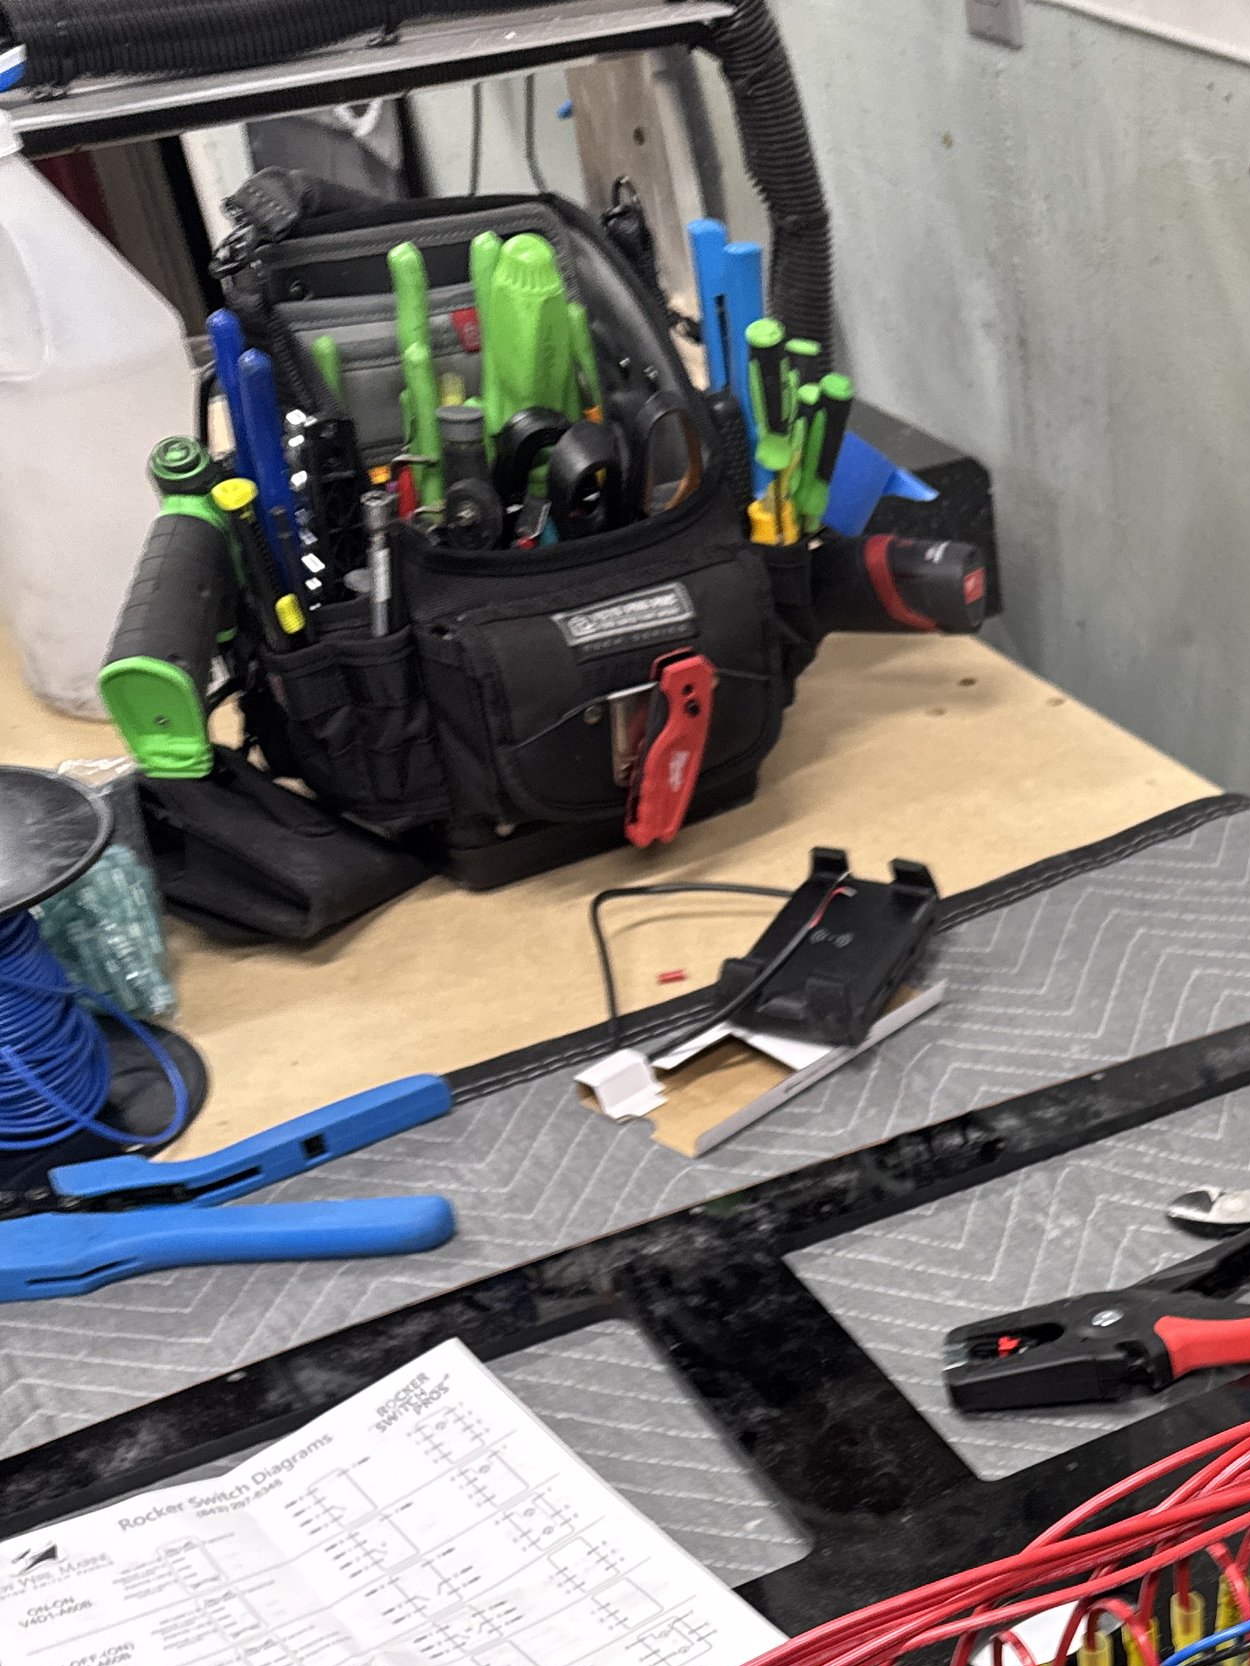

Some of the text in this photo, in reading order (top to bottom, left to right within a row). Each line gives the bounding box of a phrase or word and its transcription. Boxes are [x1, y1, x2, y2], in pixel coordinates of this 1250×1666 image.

[375, 1388, 427, 1433] SWITCH
[376, 1372, 429, 1417] ROCKER
[412, 1382, 449, 1415] PROS
[118, 1433, 333, 1531] Rocker Switch Diagrams
